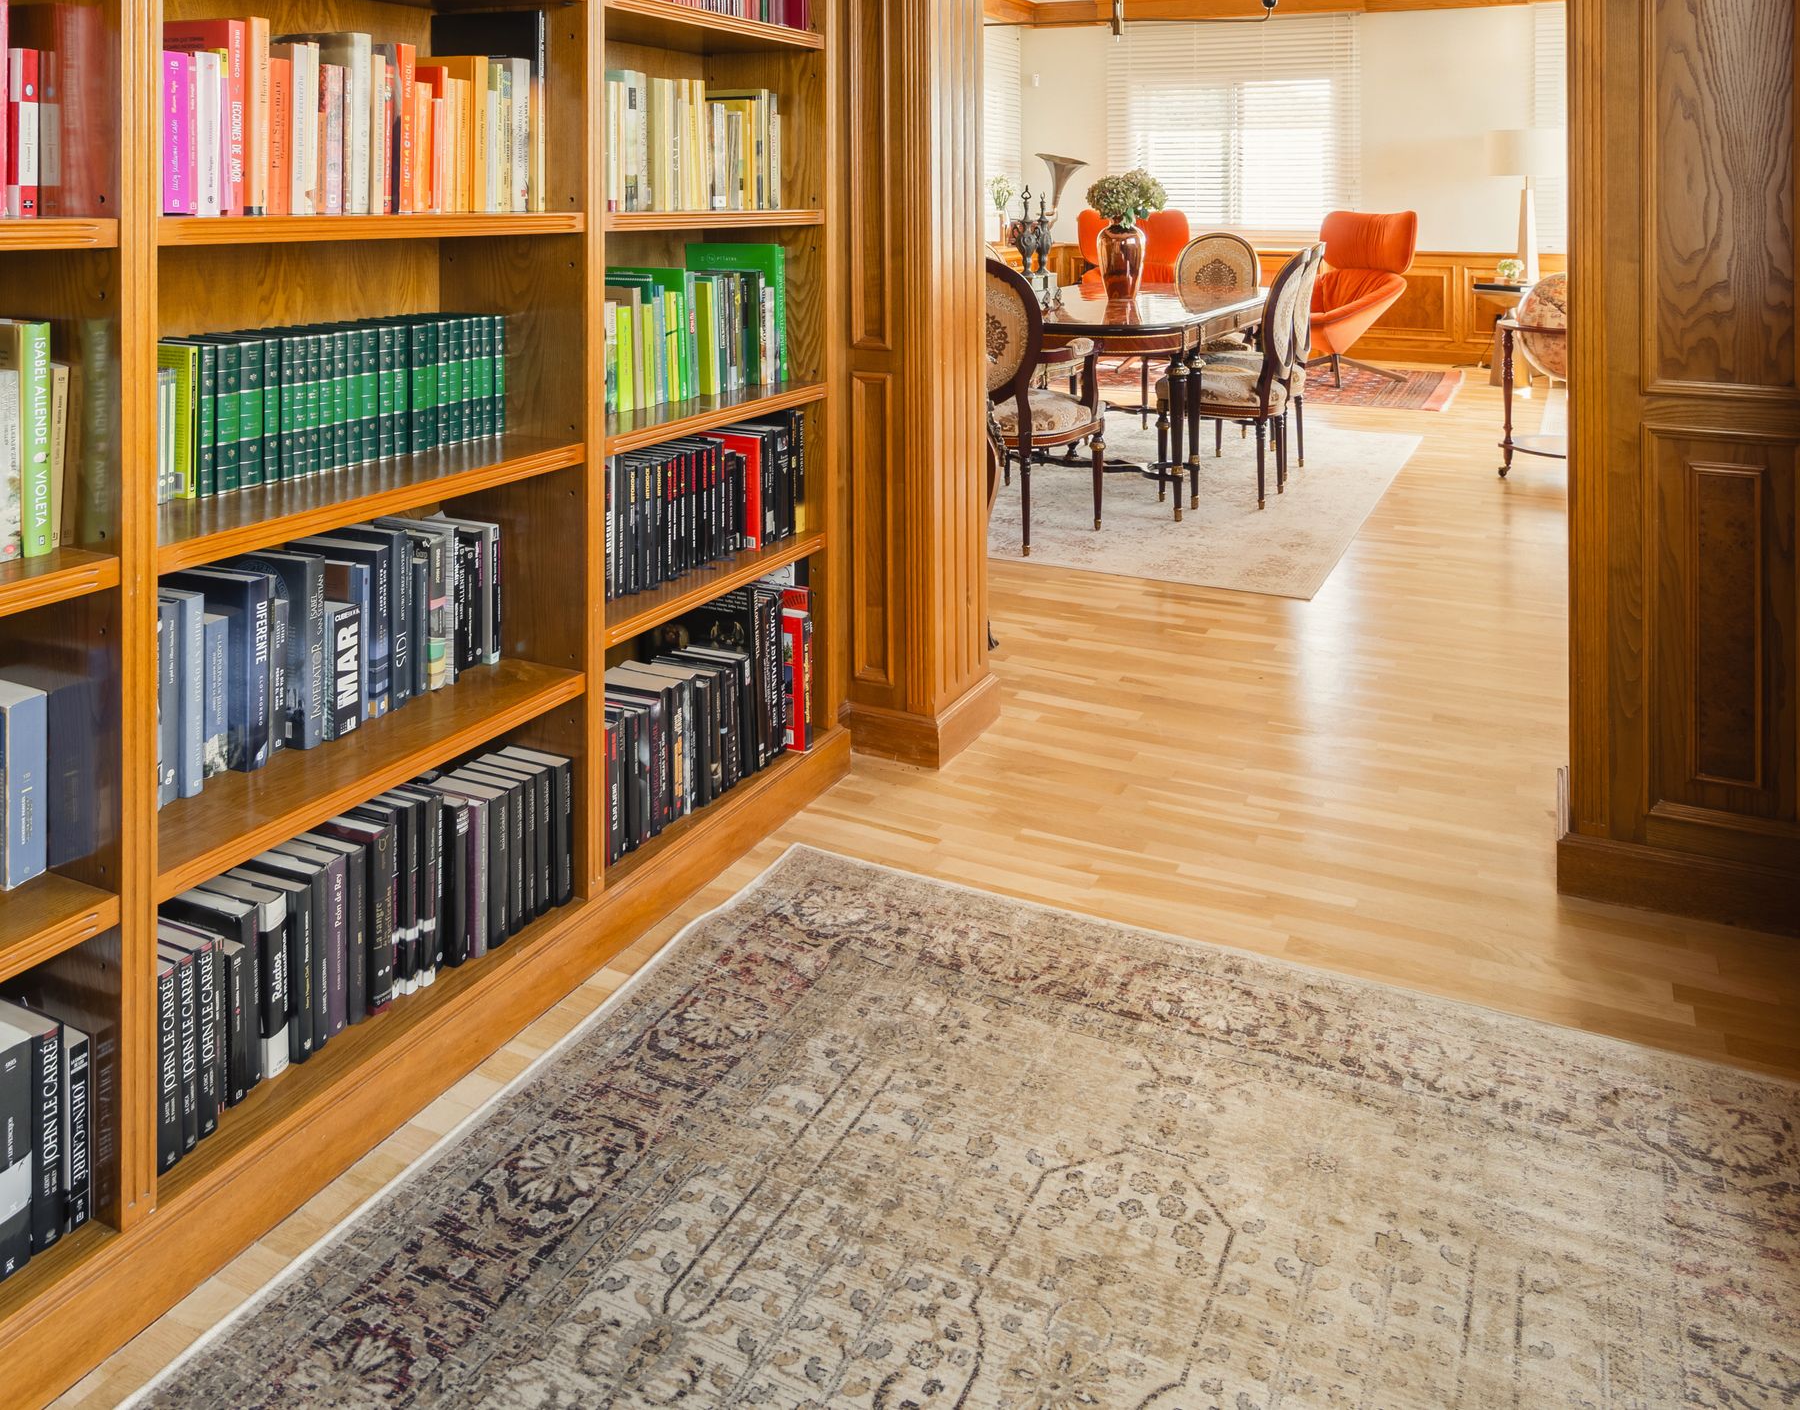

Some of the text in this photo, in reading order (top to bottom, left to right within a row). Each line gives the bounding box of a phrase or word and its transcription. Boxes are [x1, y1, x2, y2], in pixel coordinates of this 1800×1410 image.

[231, 100, 242, 183] LECCIONES DE AMOR
[272, 80, 281, 169] Paul Sussman
[34, 336, 47, 445] ISABEL ALLENDE
[34, 470, 47, 527] VIOLETA
[255, 599, 268, 665] DIFERENTE
[308, 593, 317, 620] ISABEL
[316, 617, 324, 636] SAN
[309, 639, 322, 720] IMPERATOR
[338, 622, 359, 710] MAR
[395, 630, 407, 668] SIDI
[334, 870, 343, 928] Peón de Rey
[372, 899, 383, 938] sangre
[198, 952, 215, 1065] JOHN LE CARRÉ
[271, 950, 282, 1003] Relatos
[160, 976, 178, 1095] JOHN LE CARRÉ
[180, 964, 196, 1079] JOHN LE CARRÉ
[39, 1037, 60, 1166] JOHN LE CARRÉ
[72, 1077, 88, 1187] JOHN LE CARRÉ
